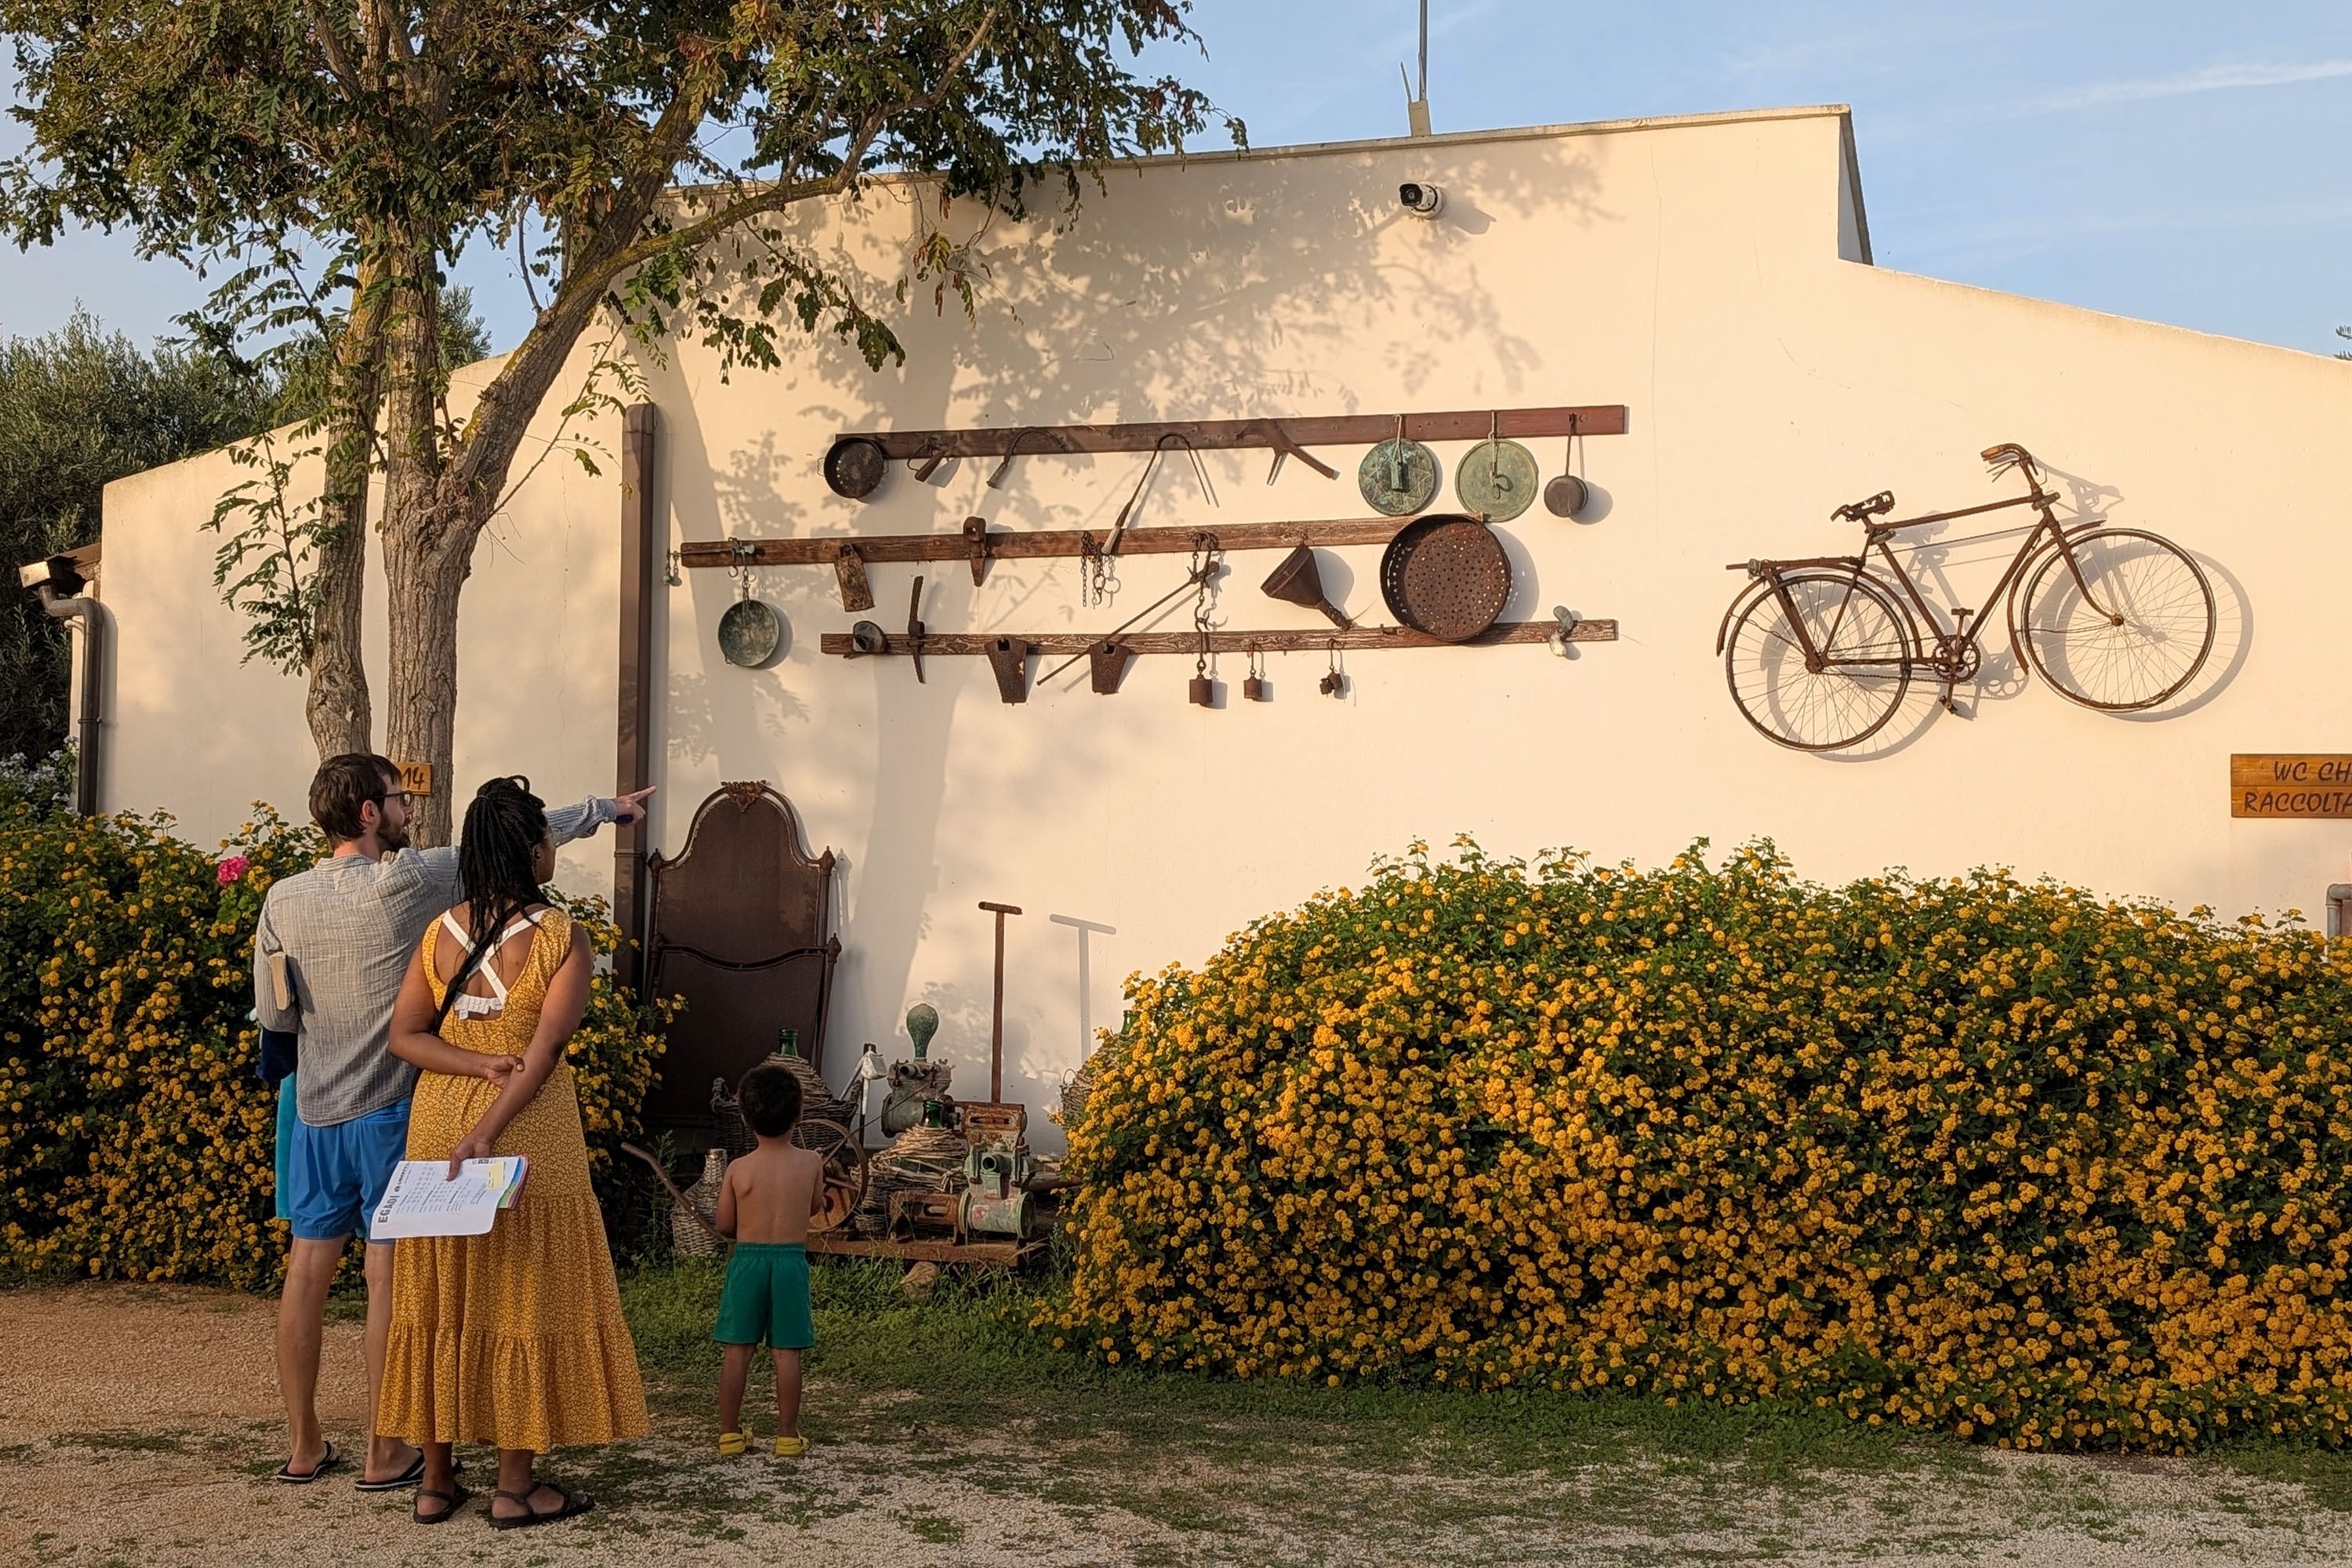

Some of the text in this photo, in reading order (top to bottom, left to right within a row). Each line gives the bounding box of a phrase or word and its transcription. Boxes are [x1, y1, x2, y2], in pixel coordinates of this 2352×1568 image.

[2274, 760, 2352, 783] WC CH
[2244, 791, 2352, 813] RACCOLTA
[378, 1195, 399, 1223] EGADI
